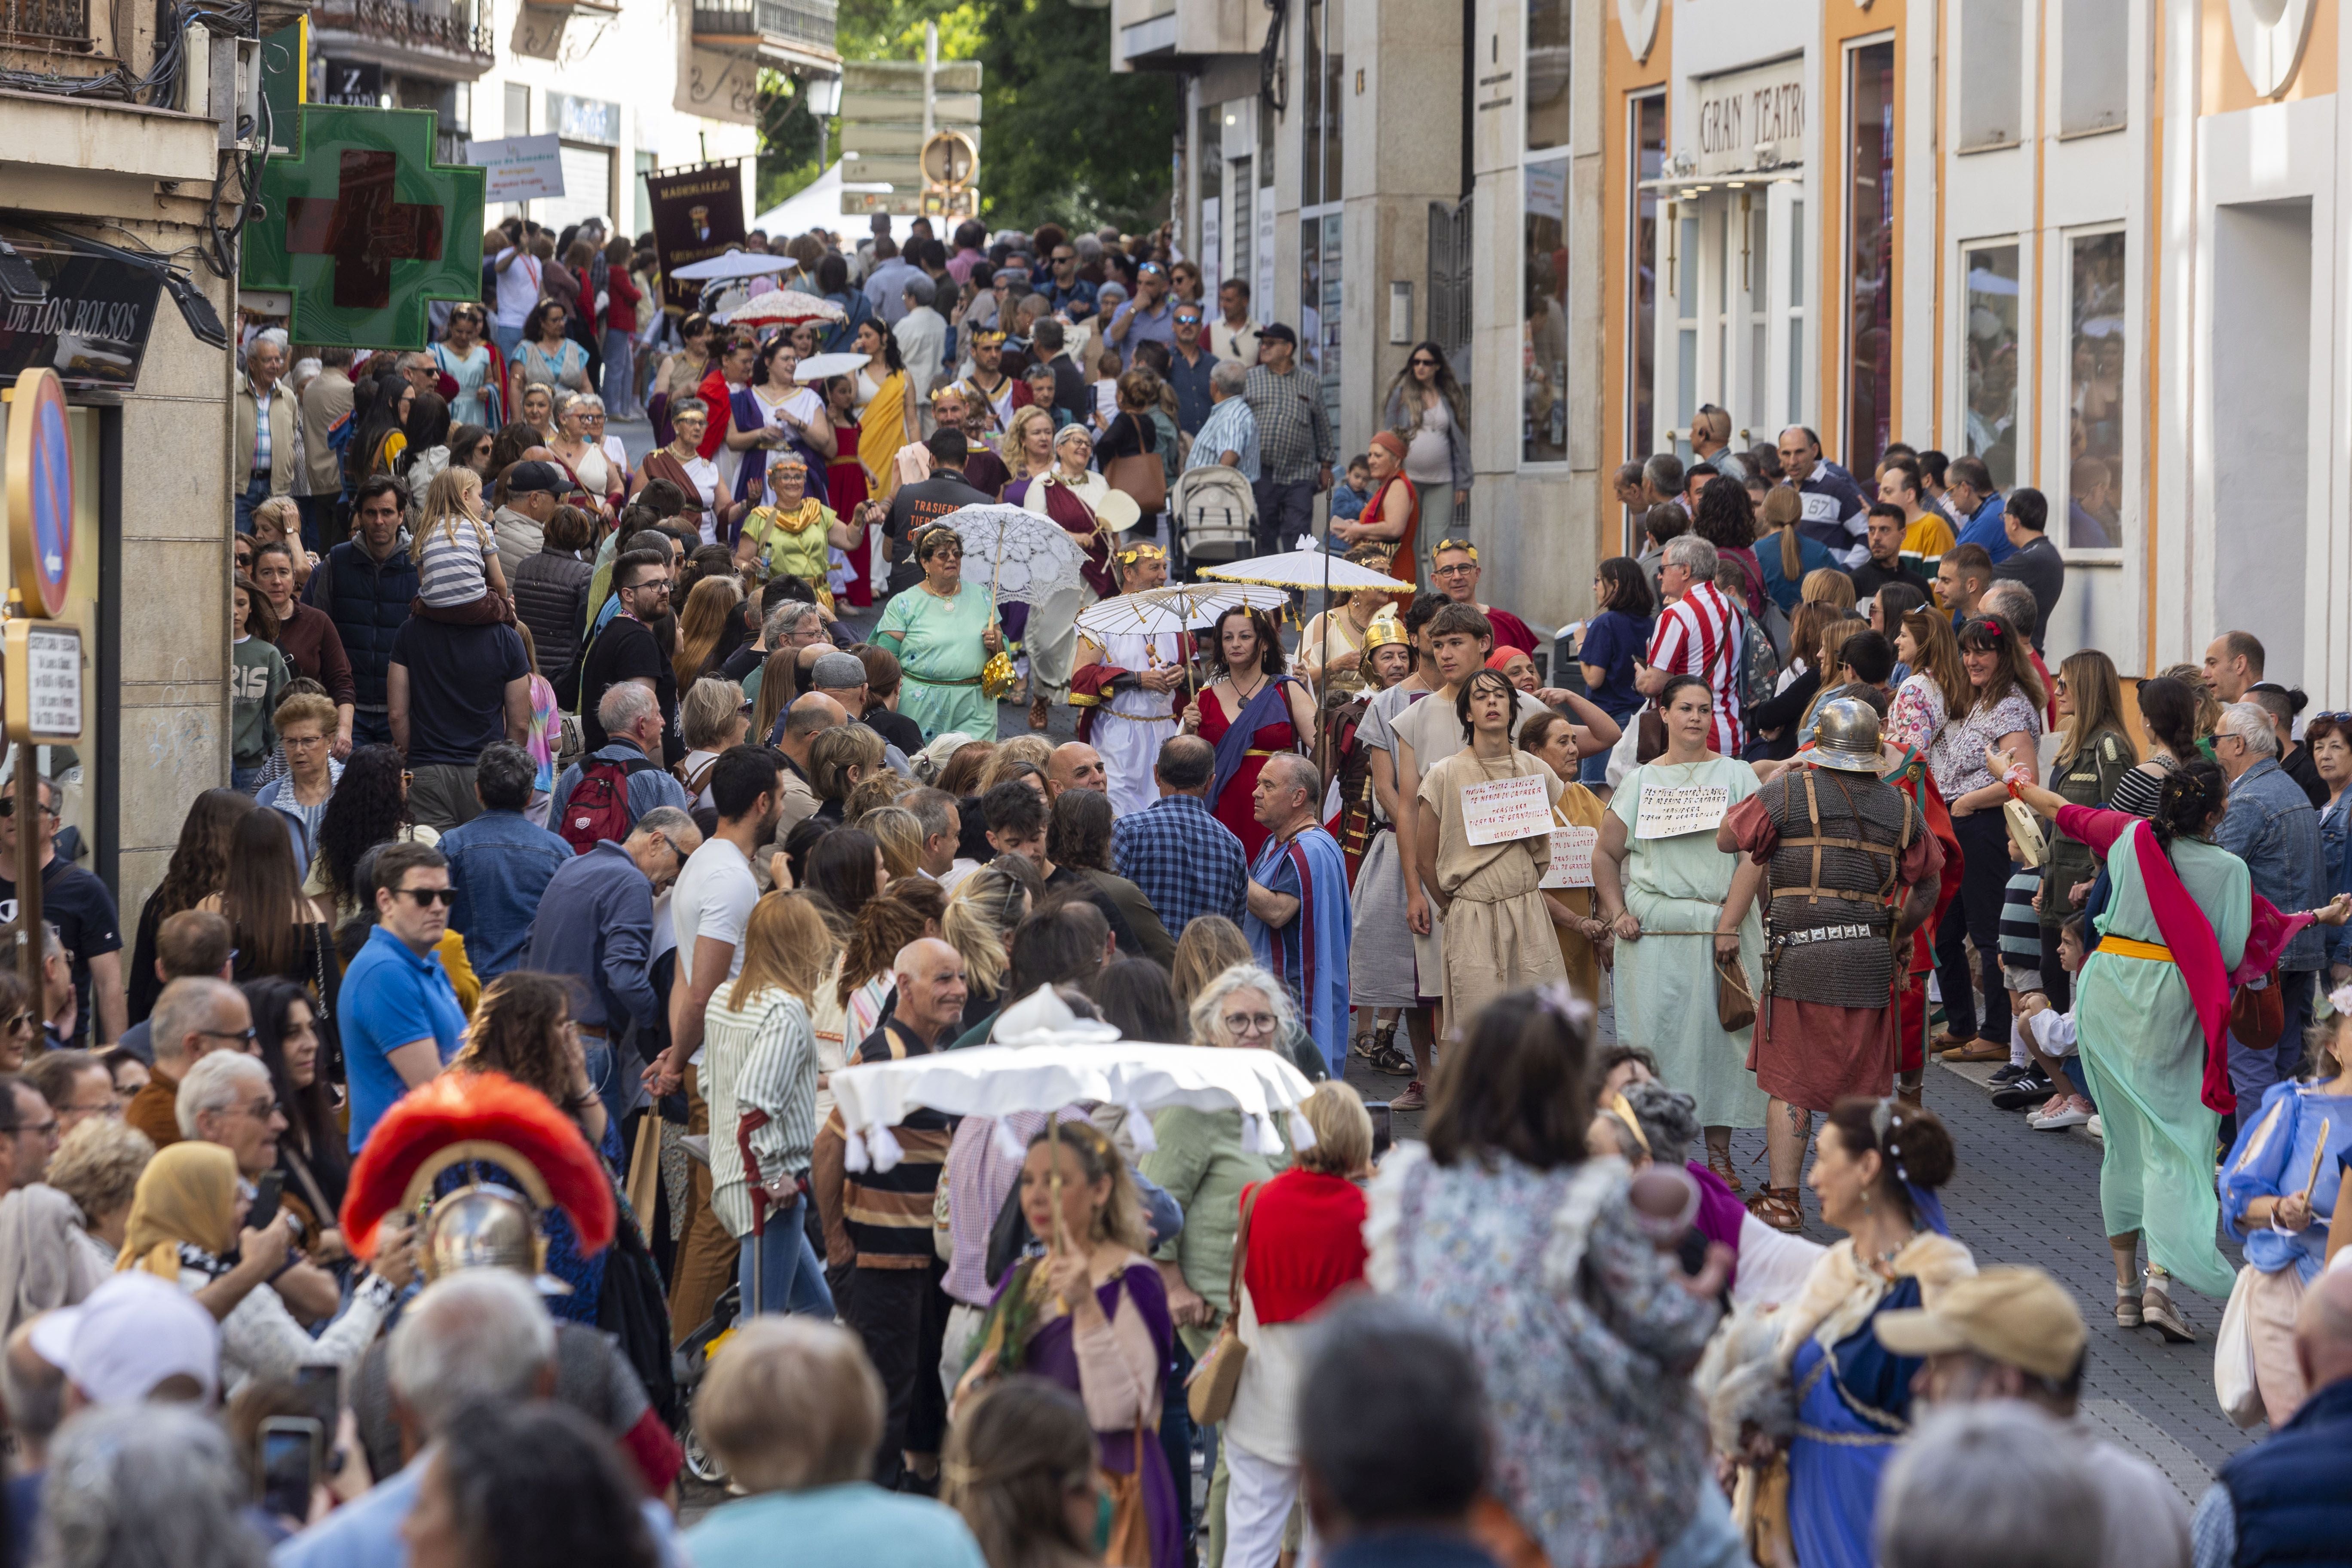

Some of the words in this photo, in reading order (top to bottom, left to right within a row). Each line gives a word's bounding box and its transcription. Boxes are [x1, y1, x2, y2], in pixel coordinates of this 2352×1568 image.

[343, 68, 361, 93] Z
[1700, 93, 1742, 153] GRAN
[3, 305, 31, 332] DE
[30, 297, 71, 336] LOS
[69, 300, 139, 340] BOLSOS
[1808, 499, 1829, 516] 67
[1492, 803, 1527, 814] TRASIERRA
[1498, 815, 1505, 823] DE
[1562, 876, 1591, 885] GALLA
